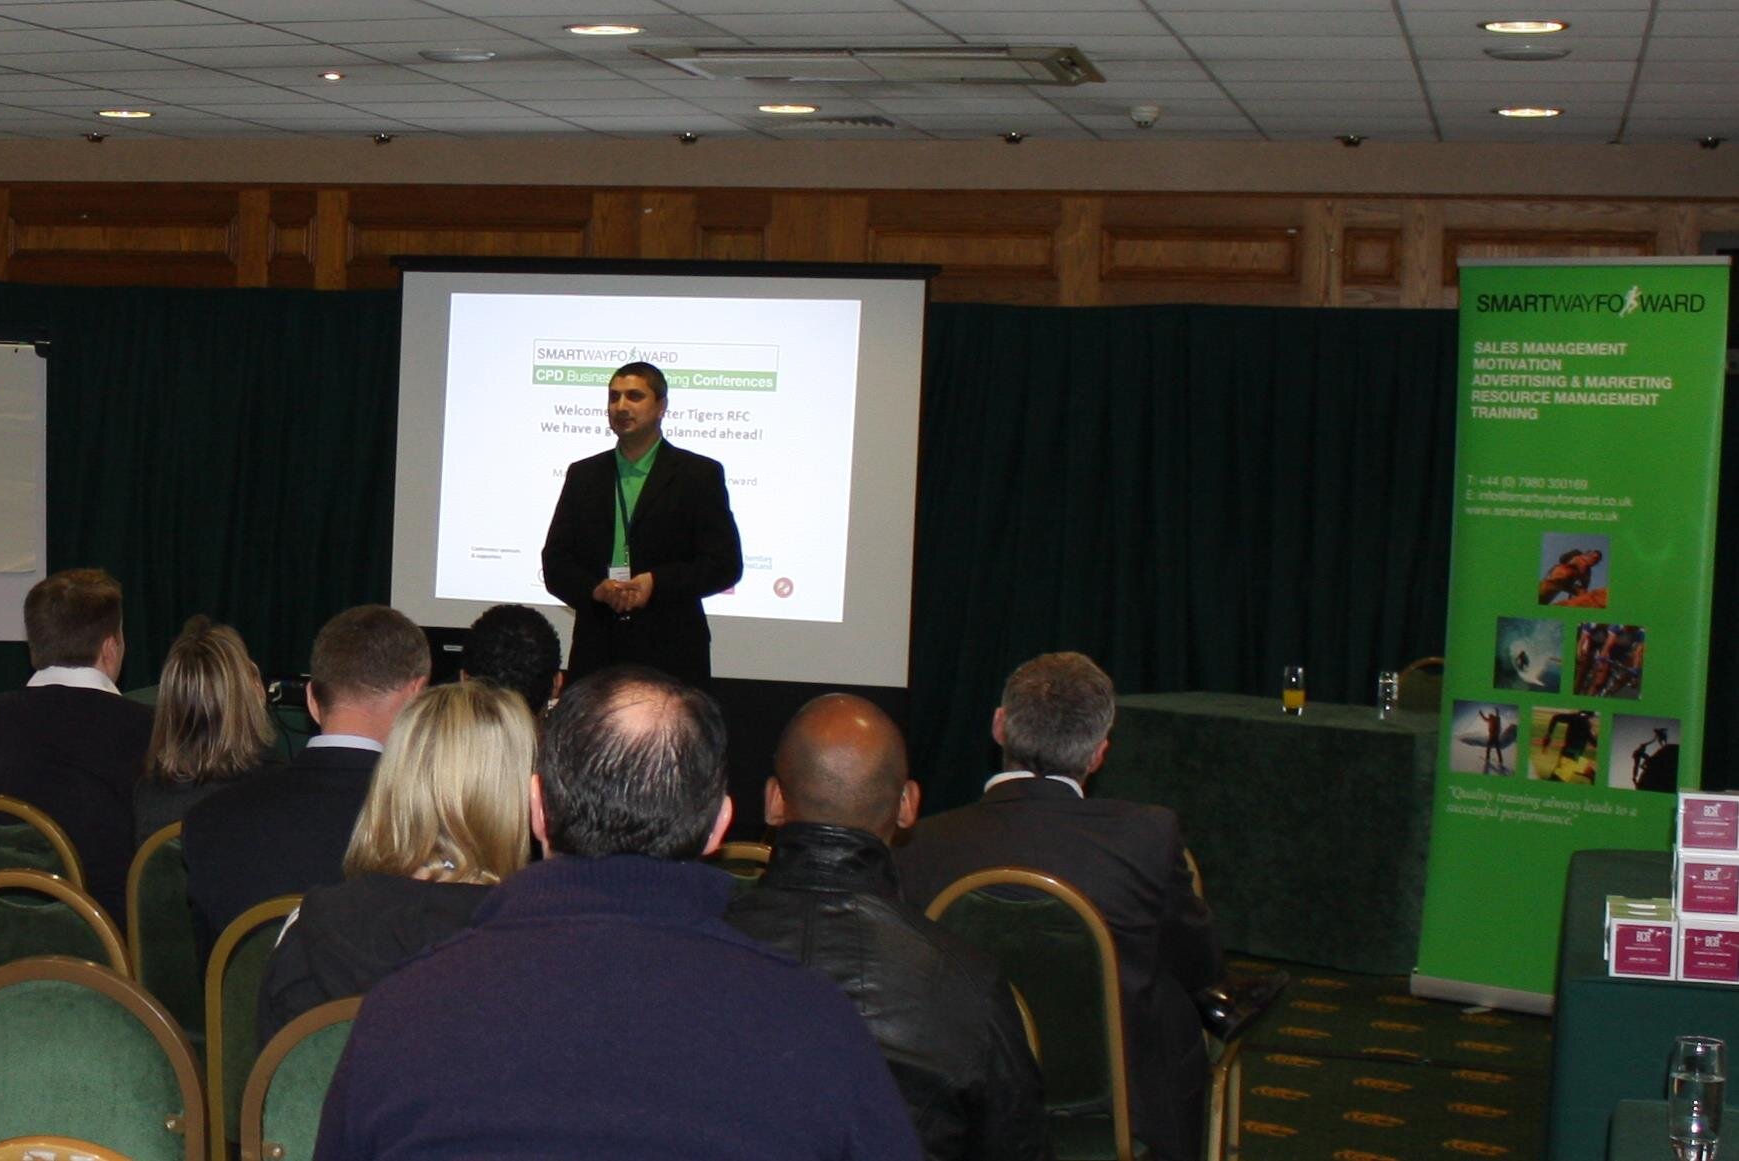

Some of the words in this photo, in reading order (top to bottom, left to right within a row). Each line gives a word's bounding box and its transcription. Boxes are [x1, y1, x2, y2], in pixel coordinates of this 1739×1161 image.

[1473, 341, 1519, 355] SALES
[1523, 342, 1628, 356] MANAGEMENT
[1473, 358, 1562, 371] MOTIVATION
[535, 369, 564, 382] CPD
[666, 372, 690, 388] hing
[692, 373, 774, 388] Conferences
[1472, 374, 1567, 388] ADVERTISING
[1570, 376, 1581, 388] &
[1585, 376, 1673, 390] MARKETING
[1471, 390, 1550, 404] RESOURCE
[1554, 391, 1659, 406] MANAGEMENT
[554, 405, 610, 417] Welcome
[663, 409, 686, 420] ter
[687, 409, 724, 422] Tigers
[727, 410, 751, 422] RFC
[1471, 406, 1539, 420] TRAINING
[540, 422, 561, 433] We
[563, 422, 592, 434] have
[594, 425, 602, 434] a
[665, 428, 717, 440] planned
[719, 429, 764, 441] ahead!
